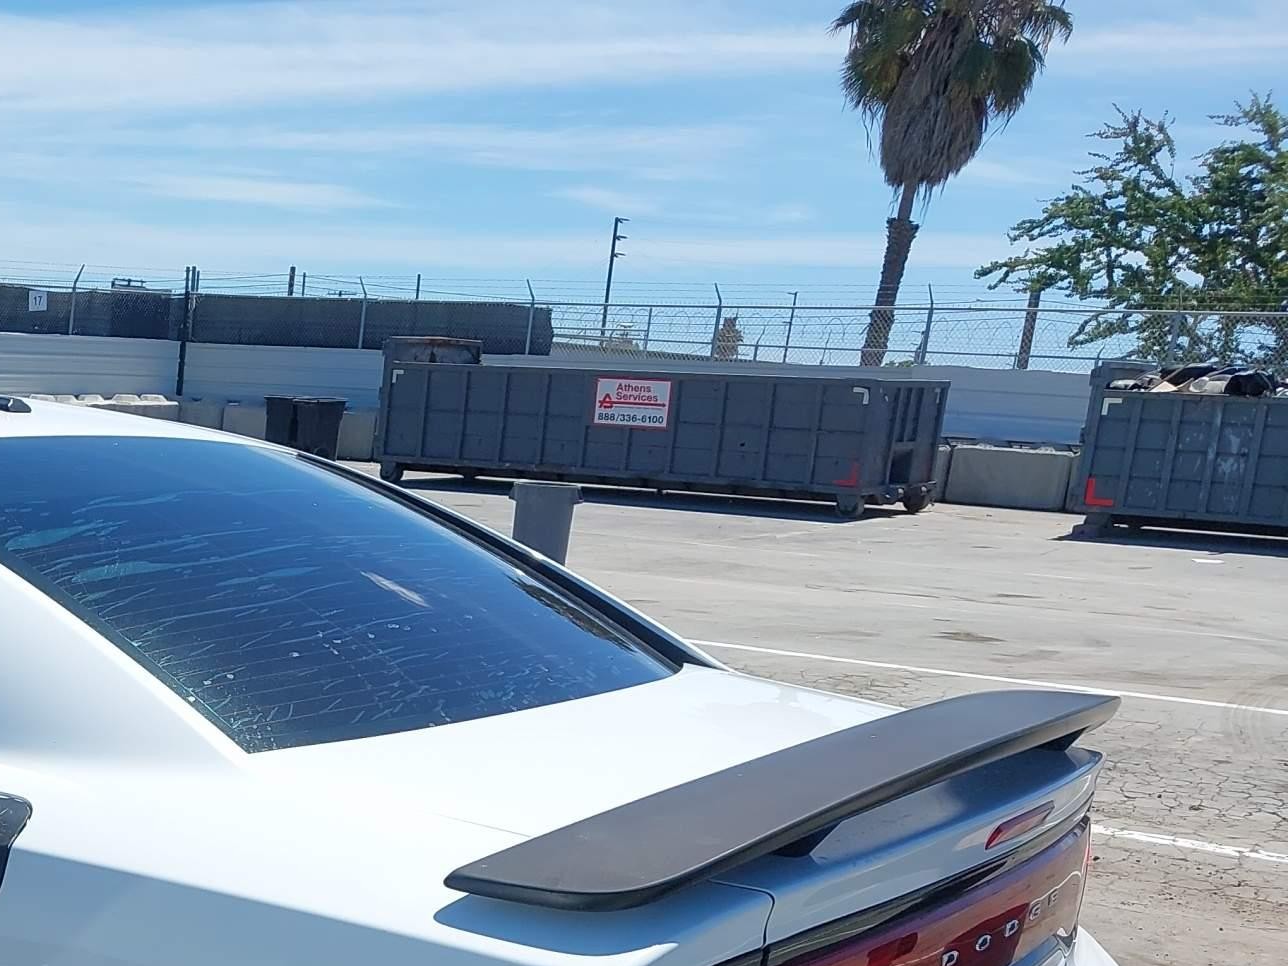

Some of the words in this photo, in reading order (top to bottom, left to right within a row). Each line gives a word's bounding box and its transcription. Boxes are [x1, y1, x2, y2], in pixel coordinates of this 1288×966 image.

[33, 295, 43, 306] 17
[616, 382, 652, 393] Athens
[615, 391, 658, 402] Services
[597, 412, 665, 424] 888/336-6100
